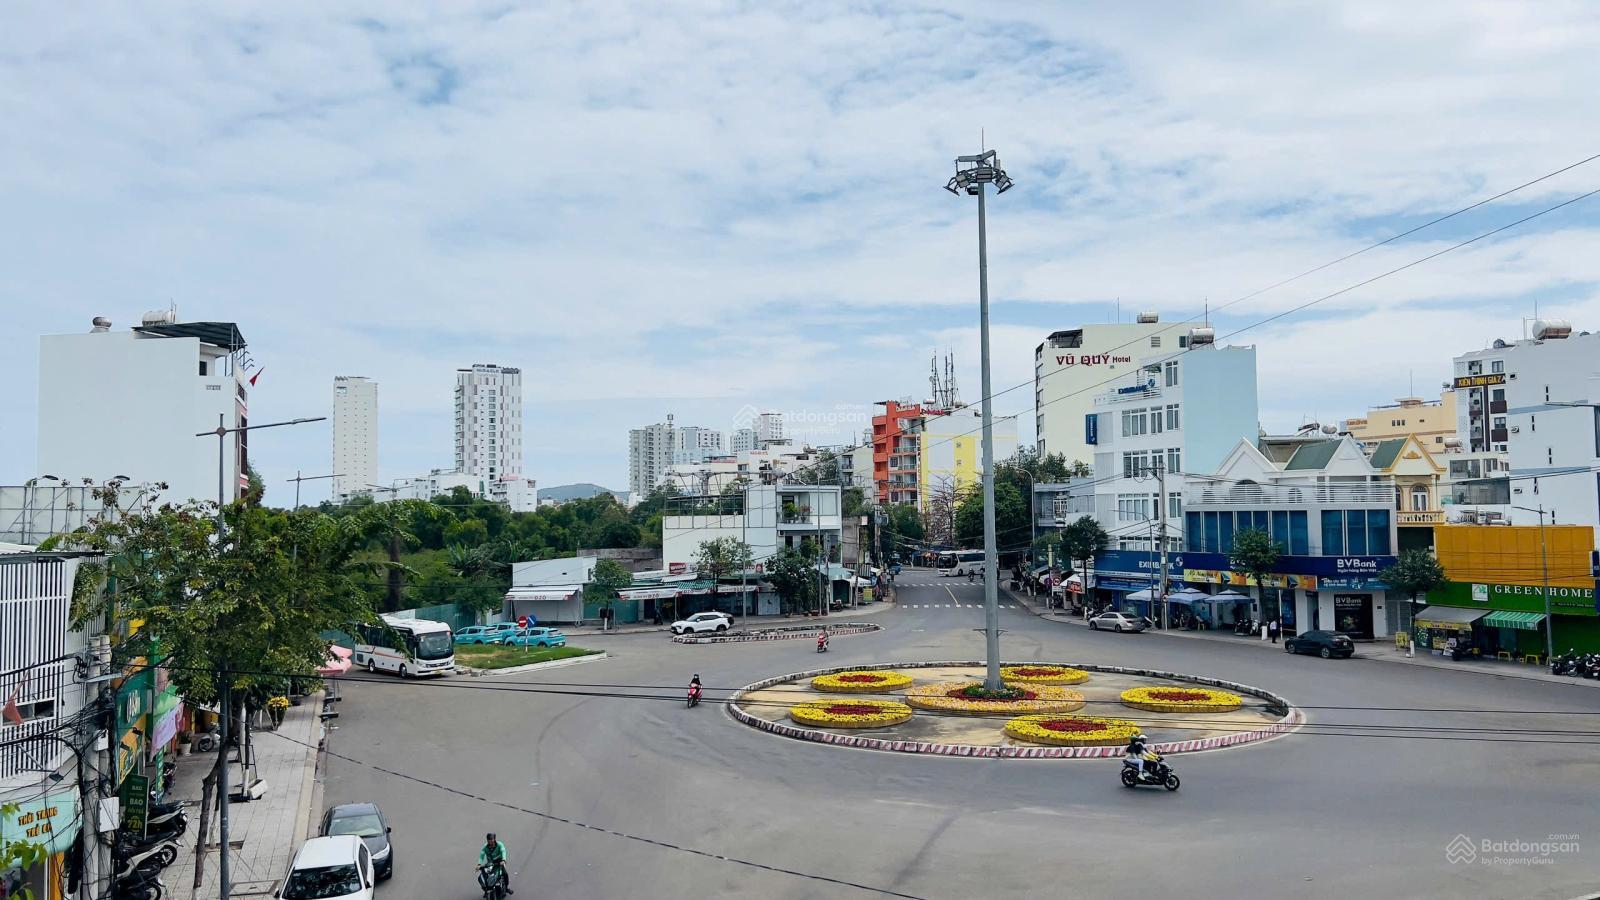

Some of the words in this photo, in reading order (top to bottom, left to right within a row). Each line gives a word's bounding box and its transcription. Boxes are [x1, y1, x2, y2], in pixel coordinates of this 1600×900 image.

[1112, 355, 1131, 363] Hotel
[1337, 559, 1377, 568] BVBank
[1494, 585, 1543, 595] GREEN
[1549, 587, 1593, 598] HOME
